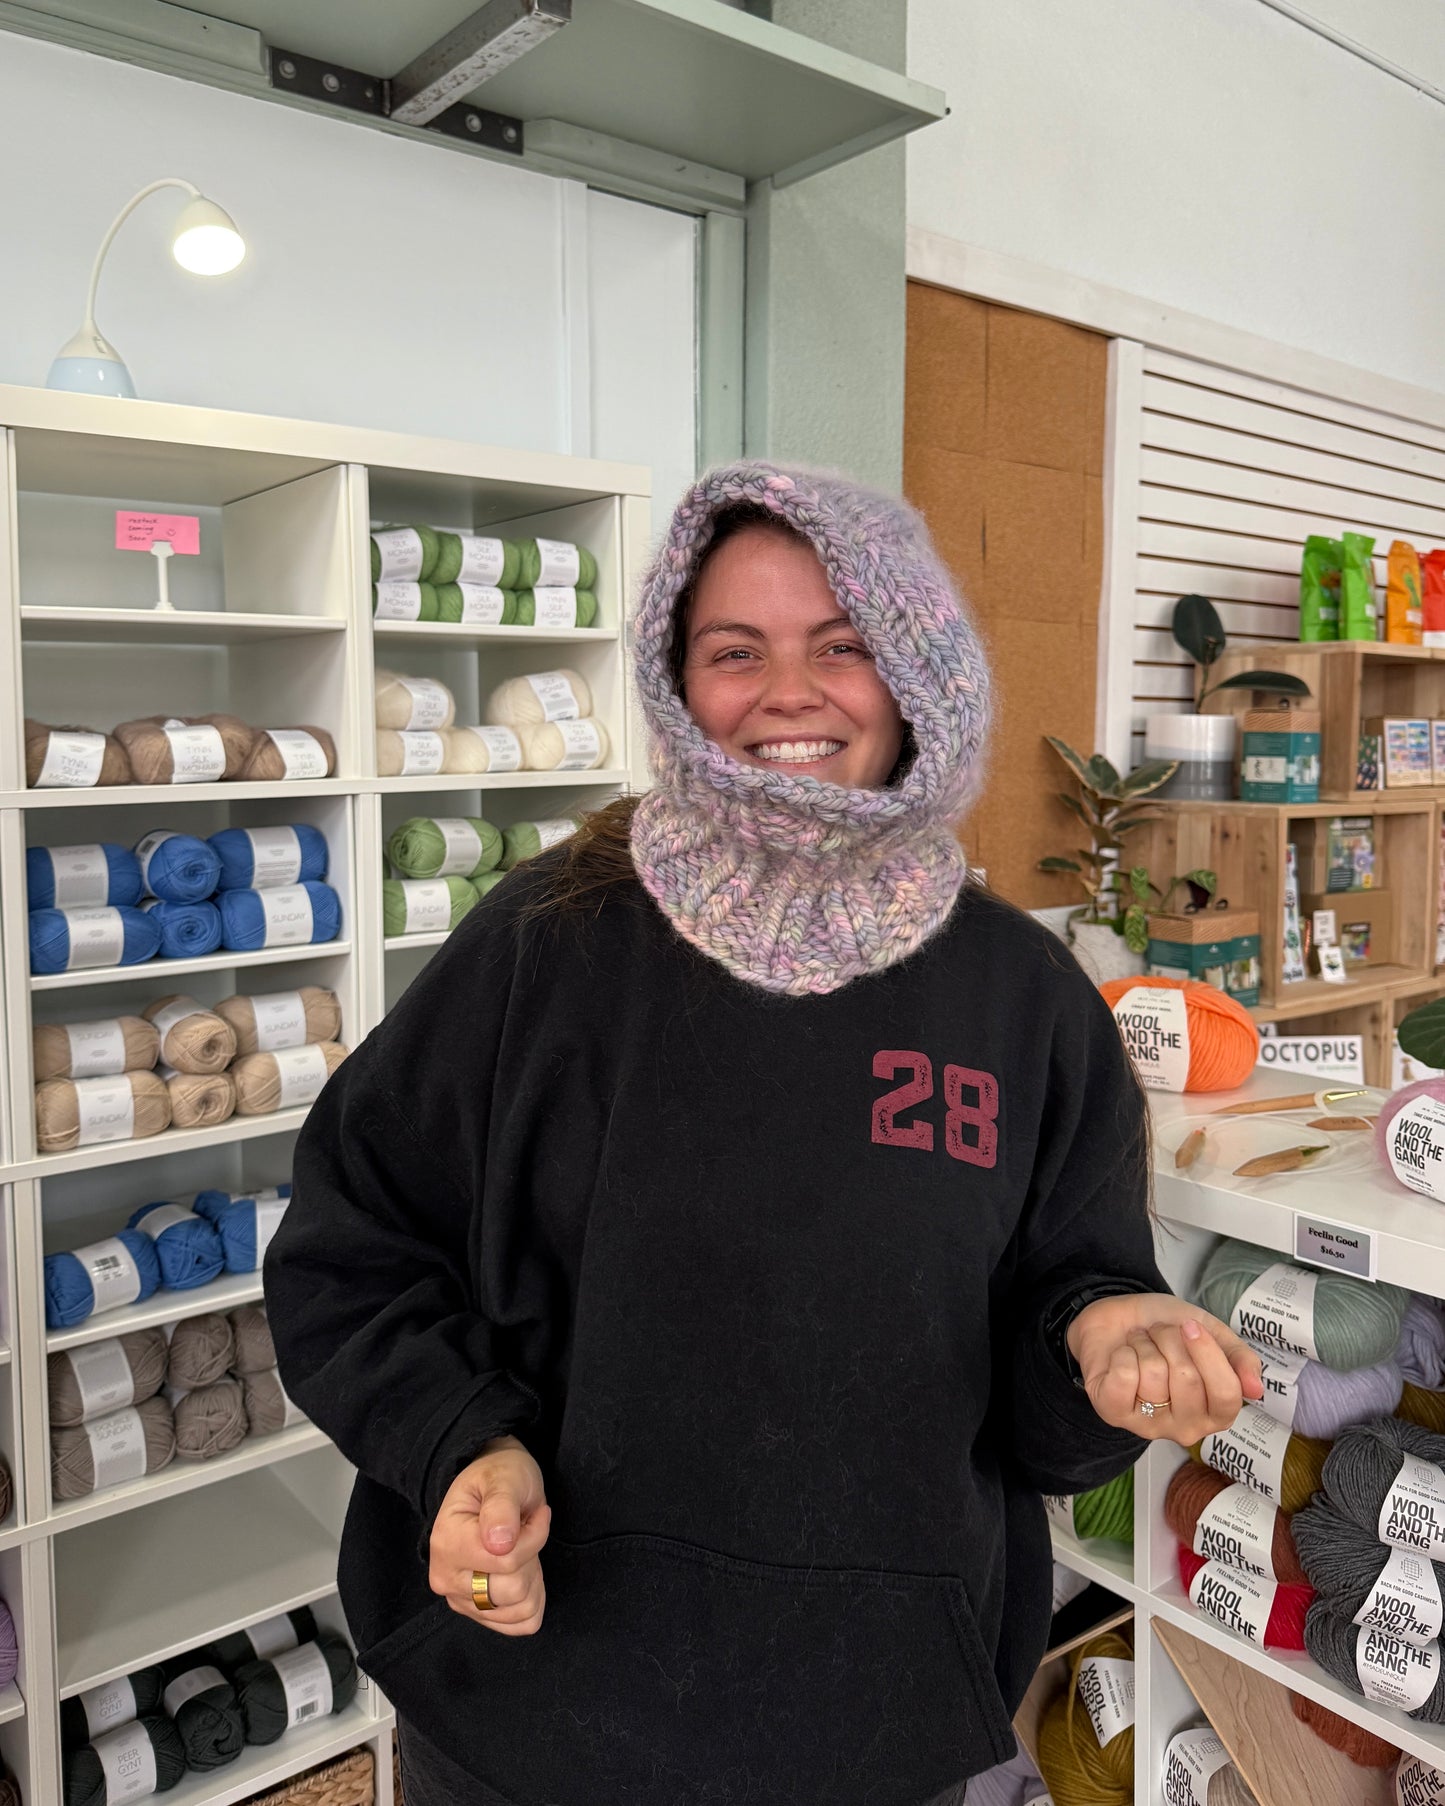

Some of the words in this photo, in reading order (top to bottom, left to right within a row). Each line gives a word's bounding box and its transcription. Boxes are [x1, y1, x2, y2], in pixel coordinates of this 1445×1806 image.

[1117, 1012, 1162, 1031] WOOL
[1128, 1045, 1160, 1062] ANG
[1150, 1031, 1182, 1049] THE
[1261, 1042, 1358, 1062] OCTOPUS
[871, 1050, 999, 1169] 28
[1398, 1118, 1432, 1142] WOOL
[1394, 1132, 1419, 1152] AND
[1422, 1140, 1444, 1162] THE
[1394, 1146, 1425, 1170] GANG
[1308, 1227, 1334, 1241] Feelin
[1336, 1235, 1358, 1248] Good
[1320, 1245, 1345, 1259] $16.50
[1240, 1308, 1286, 1341] WOOL
[1250, 1300, 1270, 1312] FEELING
[1271, 1307, 1284, 1316] GOOD
[1286, 1312, 1300, 1321] YARN
[1240, 1328, 1274, 1346] AND
[1275, 1337, 1307, 1356] THE
[1212, 1434, 1255, 1477] WOOL
[1228, 1428, 1246, 1444] FEELING
[1246, 1440, 1259, 1452] GOOD
[1260, 1447, 1272, 1459] YARN
[1208, 1452, 1240, 1478] AND
[1243, 1470, 1274, 1500] THE
[1396, 1484, 1408, 1492] BACK
[1418, 1490, 1430, 1499] GOOD
[1388, 1512, 1422, 1534] AND
[1392, 1494, 1438, 1524] WOOL
[1200, 1522, 1246, 1560] WOOL
[1212, 1514, 1230, 1528] FEELING
[1230, 1522, 1244, 1534] GOOD
[1245, 1530, 1258, 1541] YARN
[1386, 1526, 1431, 1550] GANG
[1200, 1538, 1233, 1564] AND
[1234, 1554, 1267, 1578] THE
[1201, 1573, 1242, 1616] WOOL
[1216, 1567, 1234, 1582] FEELING
[1234, 1578, 1248, 1590] GOOD
[1248, 1586, 1260, 1598] YARN
[1380, 1580, 1392, 1590] BACK
[1392, 1584, 1402, 1592] FOR
[1402, 1588, 1414, 1597] GOOD
[1196, 1592, 1226, 1621] AND
[1228, 1610, 1257, 1642] THE
[1376, 1591, 1416, 1620] WOOL
[1362, 1616, 1405, 1636] GANG
[1367, 1606, 1402, 1625] AND
[1403, 1617, 1432, 1637] THE
[1364, 1646, 1408, 1676] GANG
[1366, 1634, 1400, 1655] AND
[1402, 1644, 1432, 1670] THE
[99, 1690, 120, 1706] PEER
[1081, 1670, 1094, 1704] AND
[1088, 1662, 1106, 1716] WOOL
[100, 1700, 123, 1718] GYNT
[118, 1748, 140, 1764] PEER
[118, 1756, 142, 1776] GYNT
[1166, 1768, 1184, 1800] AND
[1168, 1748, 1192, 1794] WOOL
[1398, 1760, 1425, 1793] WOOL
[1420, 1769, 1444, 1798] THE
